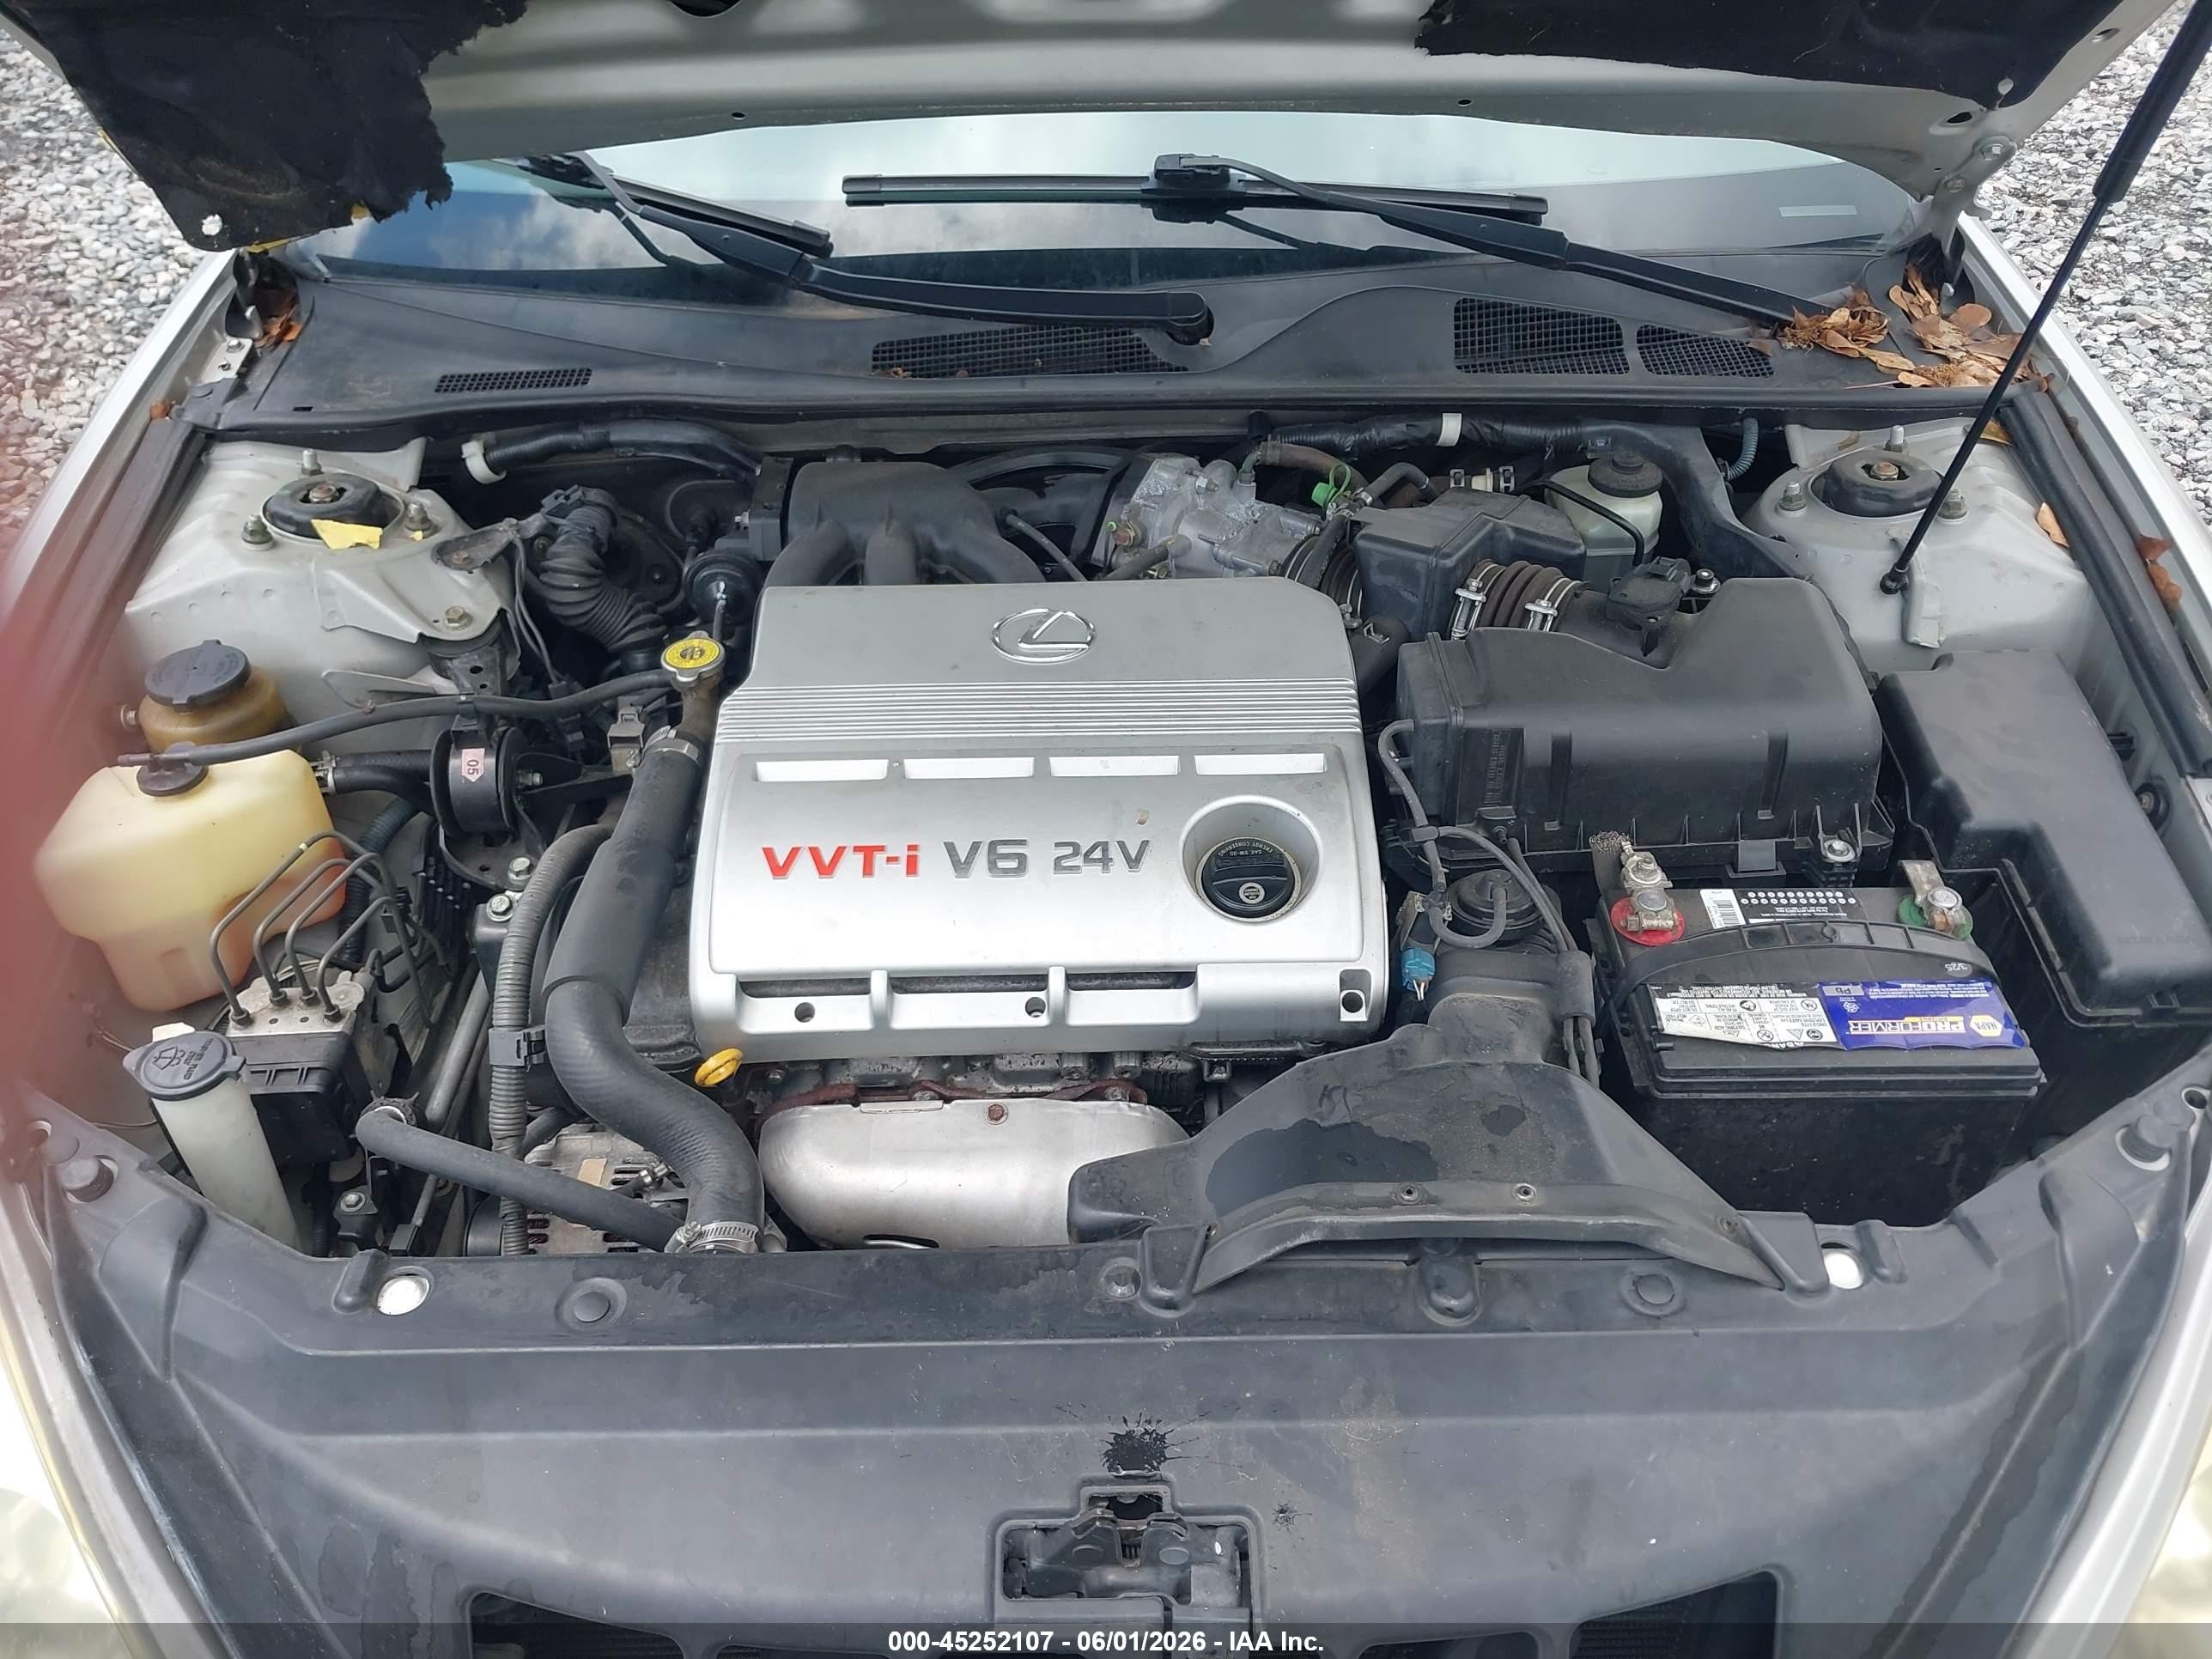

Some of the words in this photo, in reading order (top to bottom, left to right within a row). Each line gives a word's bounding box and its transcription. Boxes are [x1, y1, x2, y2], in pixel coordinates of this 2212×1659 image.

[466, 759, 479, 775] 05
[1218, 841, 1250, 857] CONSERVING
[1251, 842, 1273, 854] ENERGY
[762, 844, 921, 878] VVT-i
[943, 839, 1029, 878] V6
[1053, 839, 1151, 875] 24V
[1849, 1020, 1964, 1032] PROFORMER
[1974, 1021, 1997, 1030] NAPA
